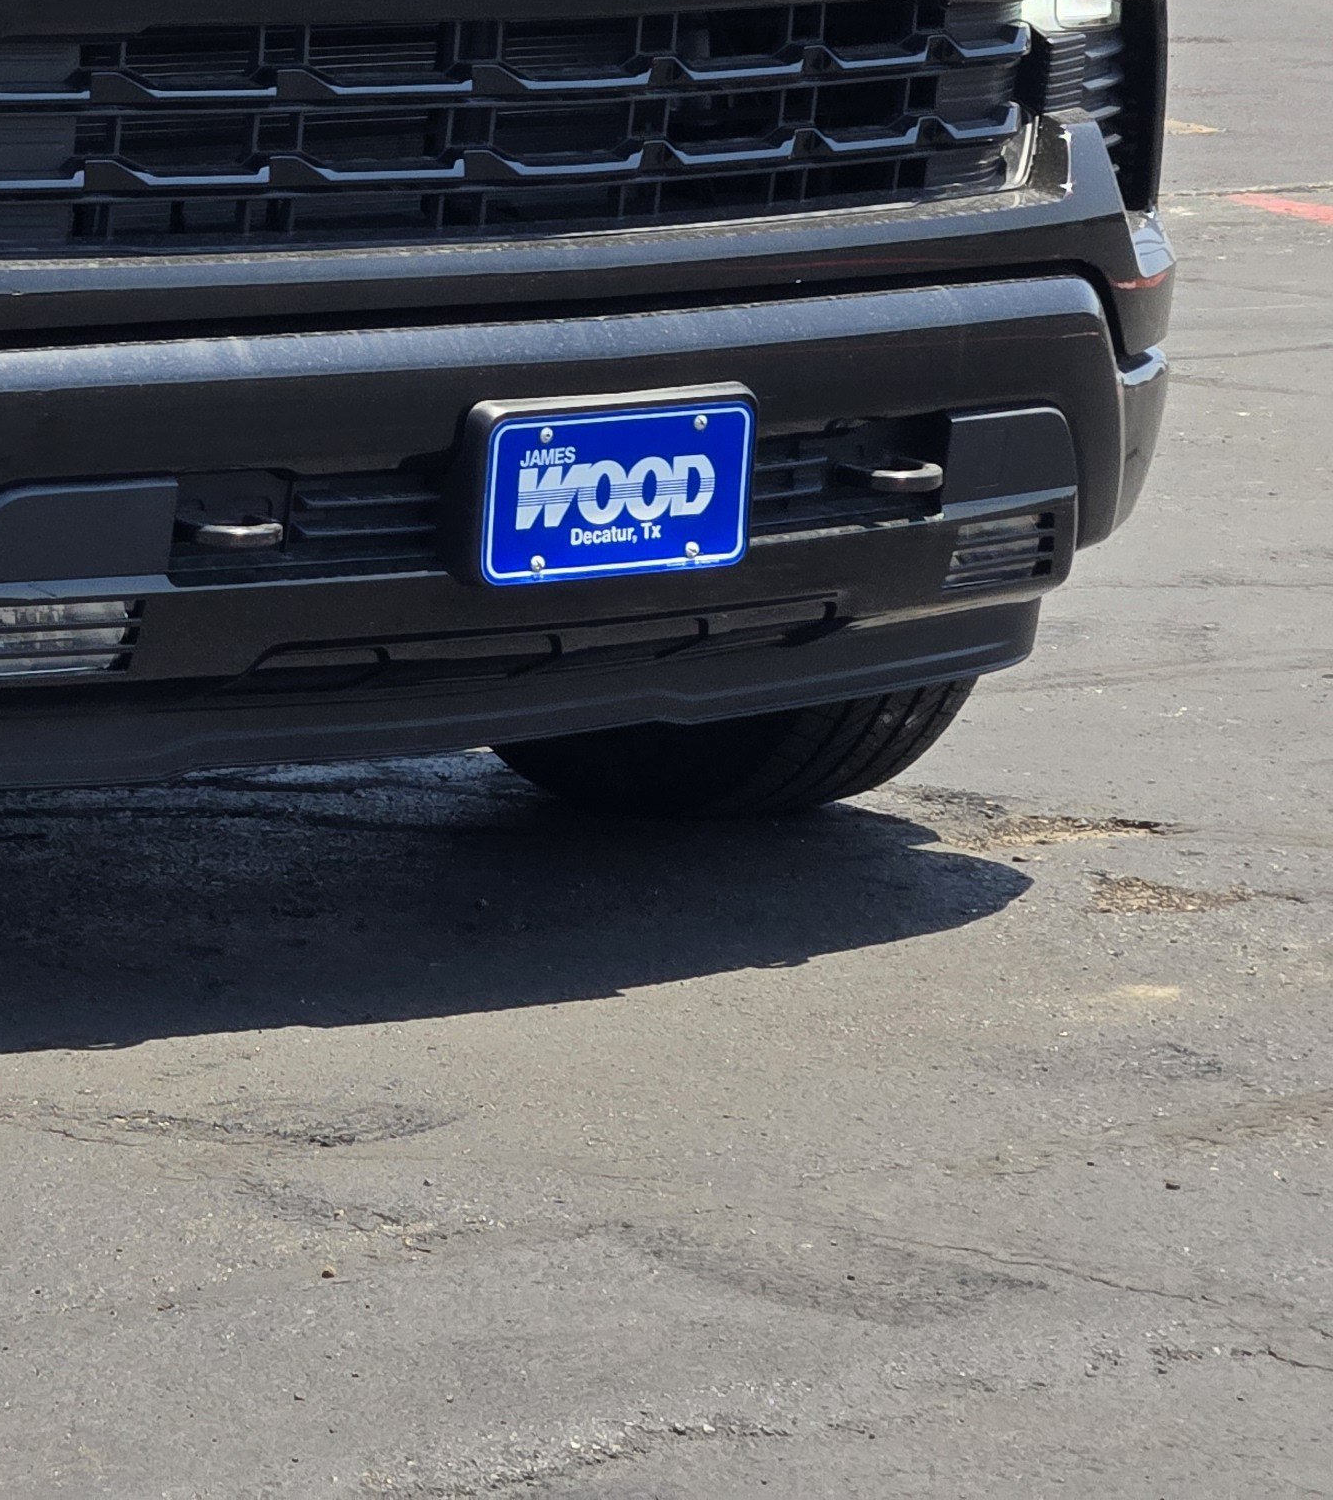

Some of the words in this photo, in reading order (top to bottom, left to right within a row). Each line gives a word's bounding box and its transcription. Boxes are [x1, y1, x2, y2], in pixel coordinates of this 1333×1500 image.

[519, 446, 576, 467] JAMES
[515, 454, 715, 530] WOOD
[570, 525, 638, 546] Decatur,
